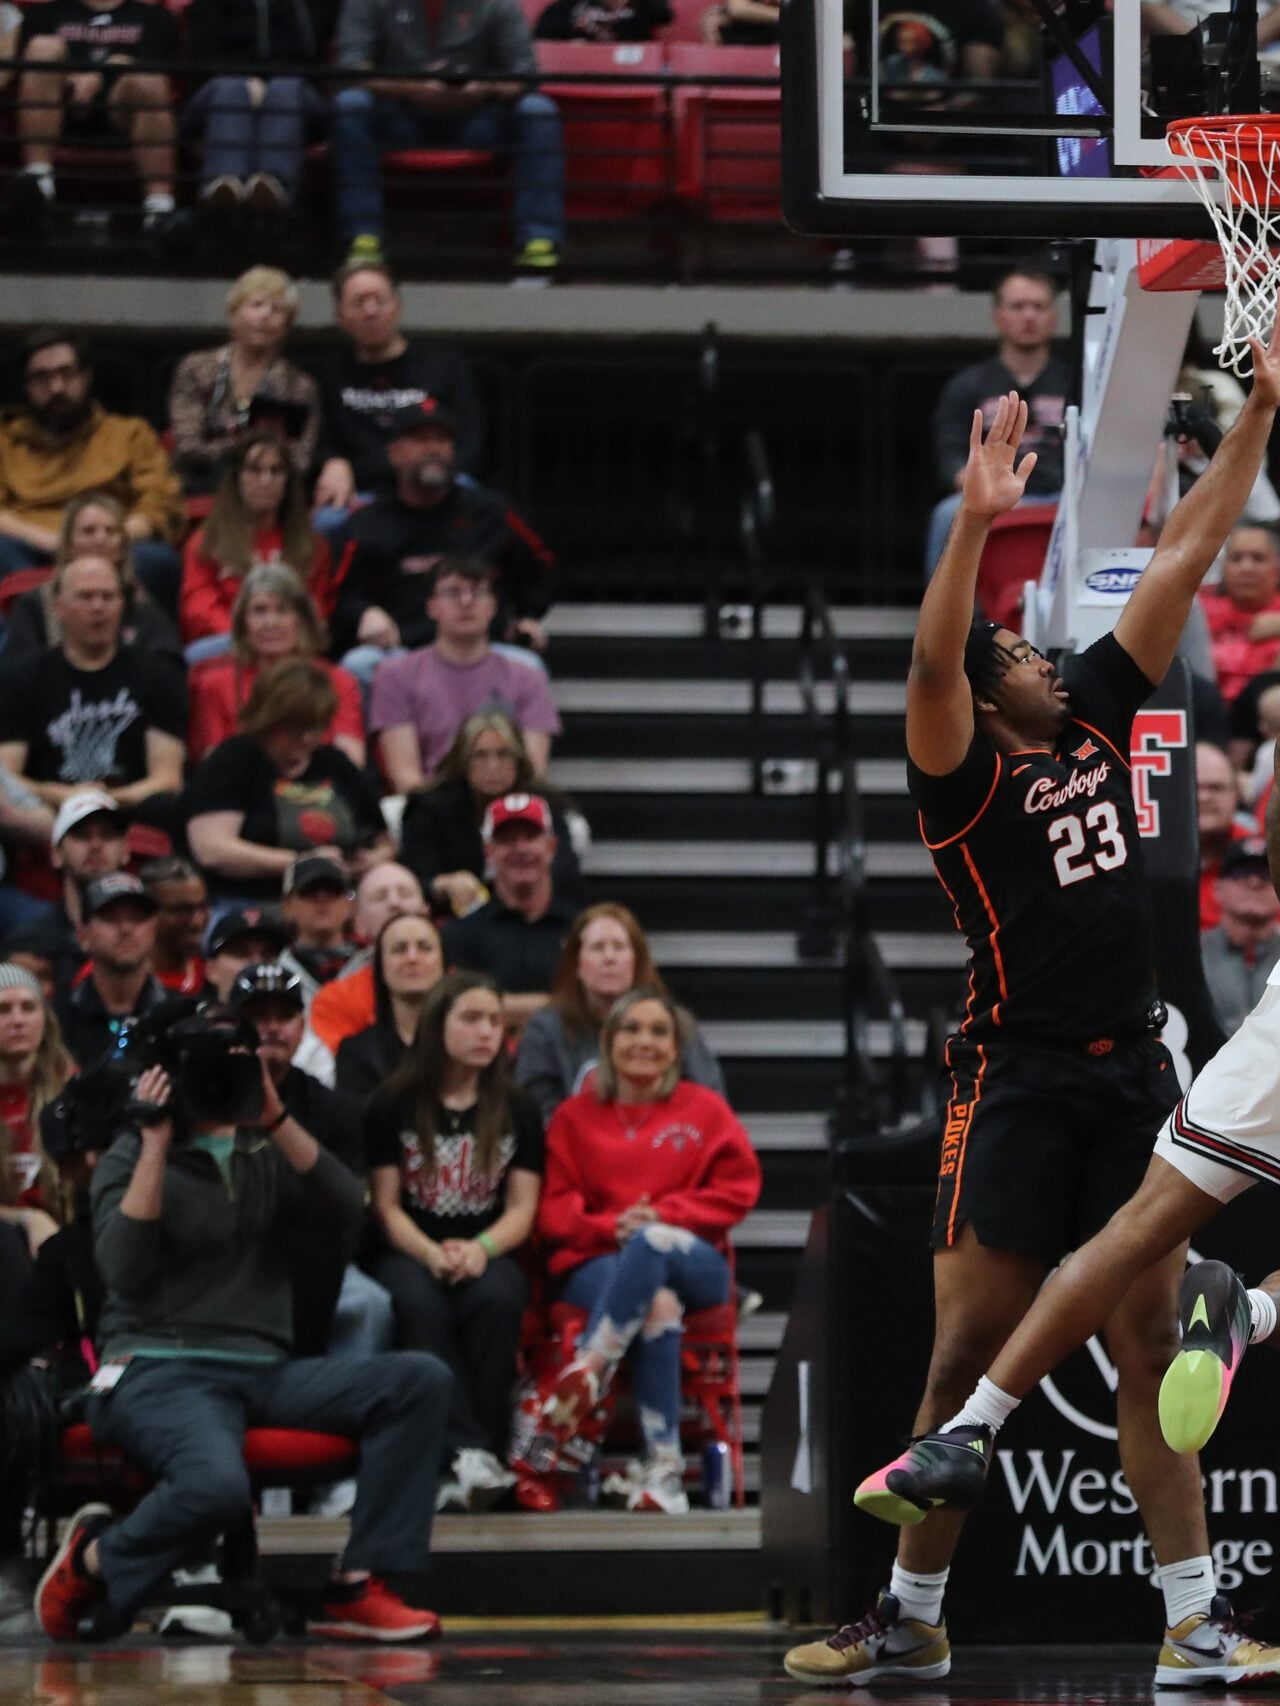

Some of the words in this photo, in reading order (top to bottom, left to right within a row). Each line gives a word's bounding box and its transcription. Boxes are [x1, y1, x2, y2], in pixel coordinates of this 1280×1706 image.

[1024, 761, 1111, 814] Cowboys
[1047, 800, 1128, 887] 23
[940, 1103, 968, 1177] POKES
[997, 1450, 1279, 1515] Wesrn
[1014, 1524, 1273, 1590] Mortge
